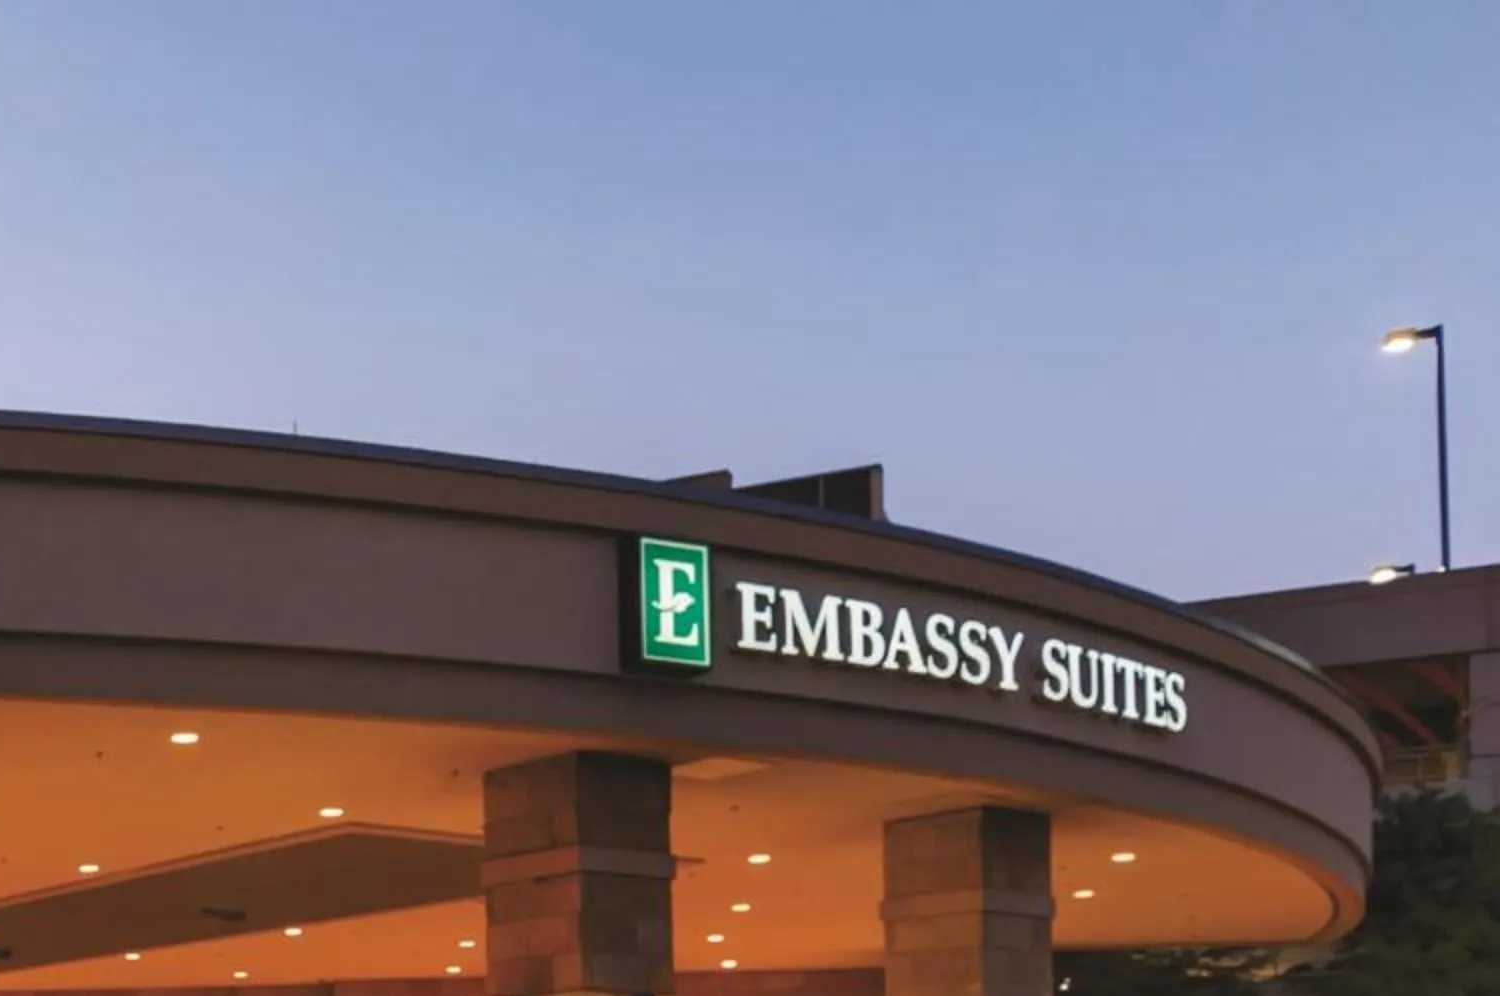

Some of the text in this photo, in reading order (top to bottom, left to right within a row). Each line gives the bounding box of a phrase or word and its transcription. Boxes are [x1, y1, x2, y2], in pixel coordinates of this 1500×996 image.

[651, 558, 699, 647] E
[735, 581, 1187, 733] EMBASSY SUITES
